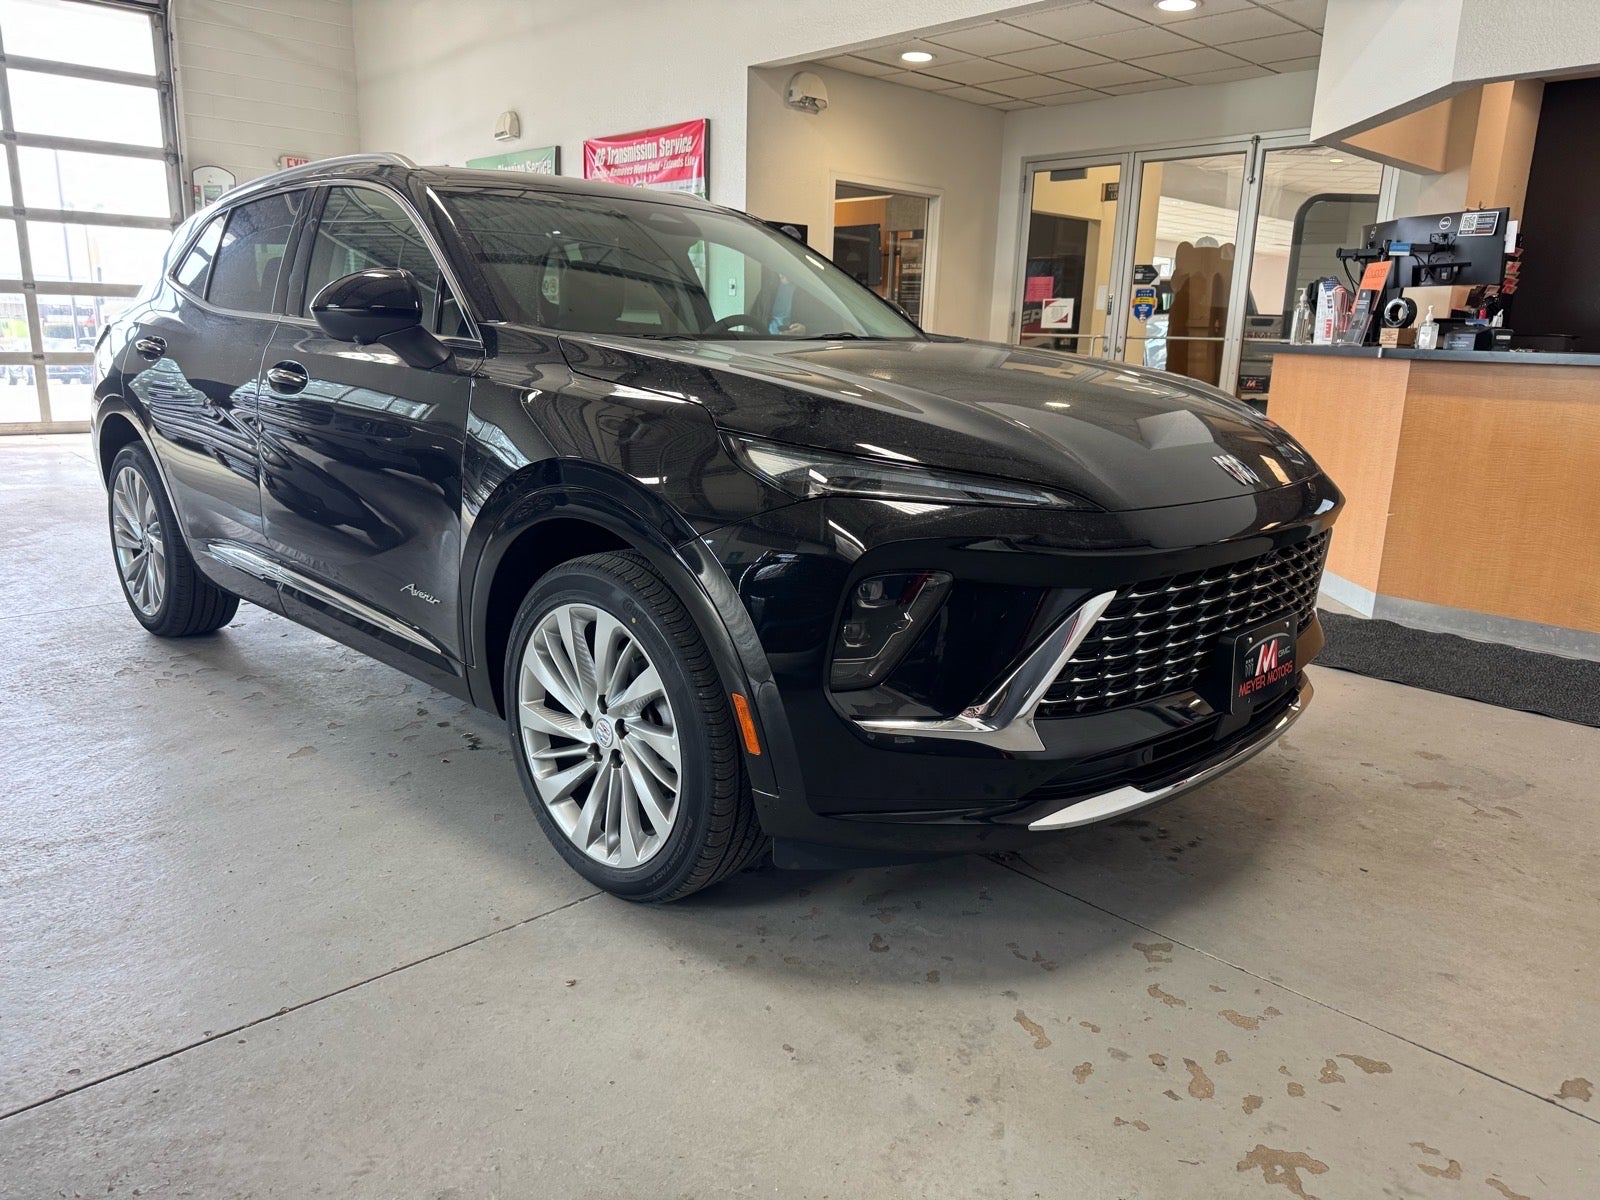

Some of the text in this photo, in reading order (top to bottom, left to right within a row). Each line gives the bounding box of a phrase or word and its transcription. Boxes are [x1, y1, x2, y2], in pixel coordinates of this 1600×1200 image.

[607, 140, 657, 165] Transmission
[659, 134, 693, 156] Service
[527, 160, 552, 175] Service
[1238, 661, 1293, 697] MEYER MOTORS
